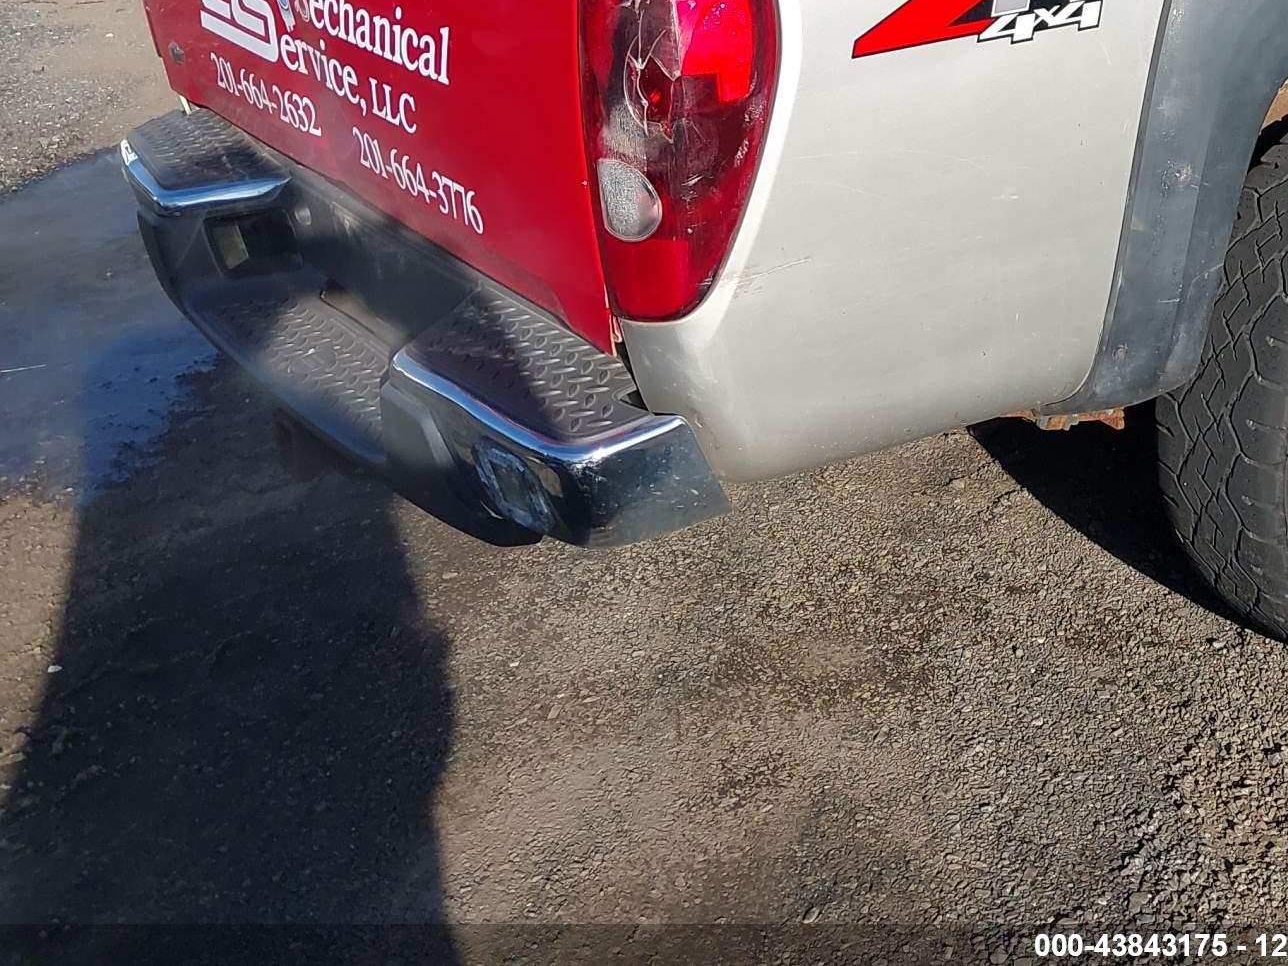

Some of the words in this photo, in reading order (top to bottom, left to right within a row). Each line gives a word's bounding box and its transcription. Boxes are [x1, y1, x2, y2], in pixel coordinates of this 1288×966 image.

[976, 0, 1102, 45] 4x4
[209, 51, 323, 138] 201-664-2632
[368, 76, 417, 134] LLC
[352, 125, 485, 235] 201-664-3776
